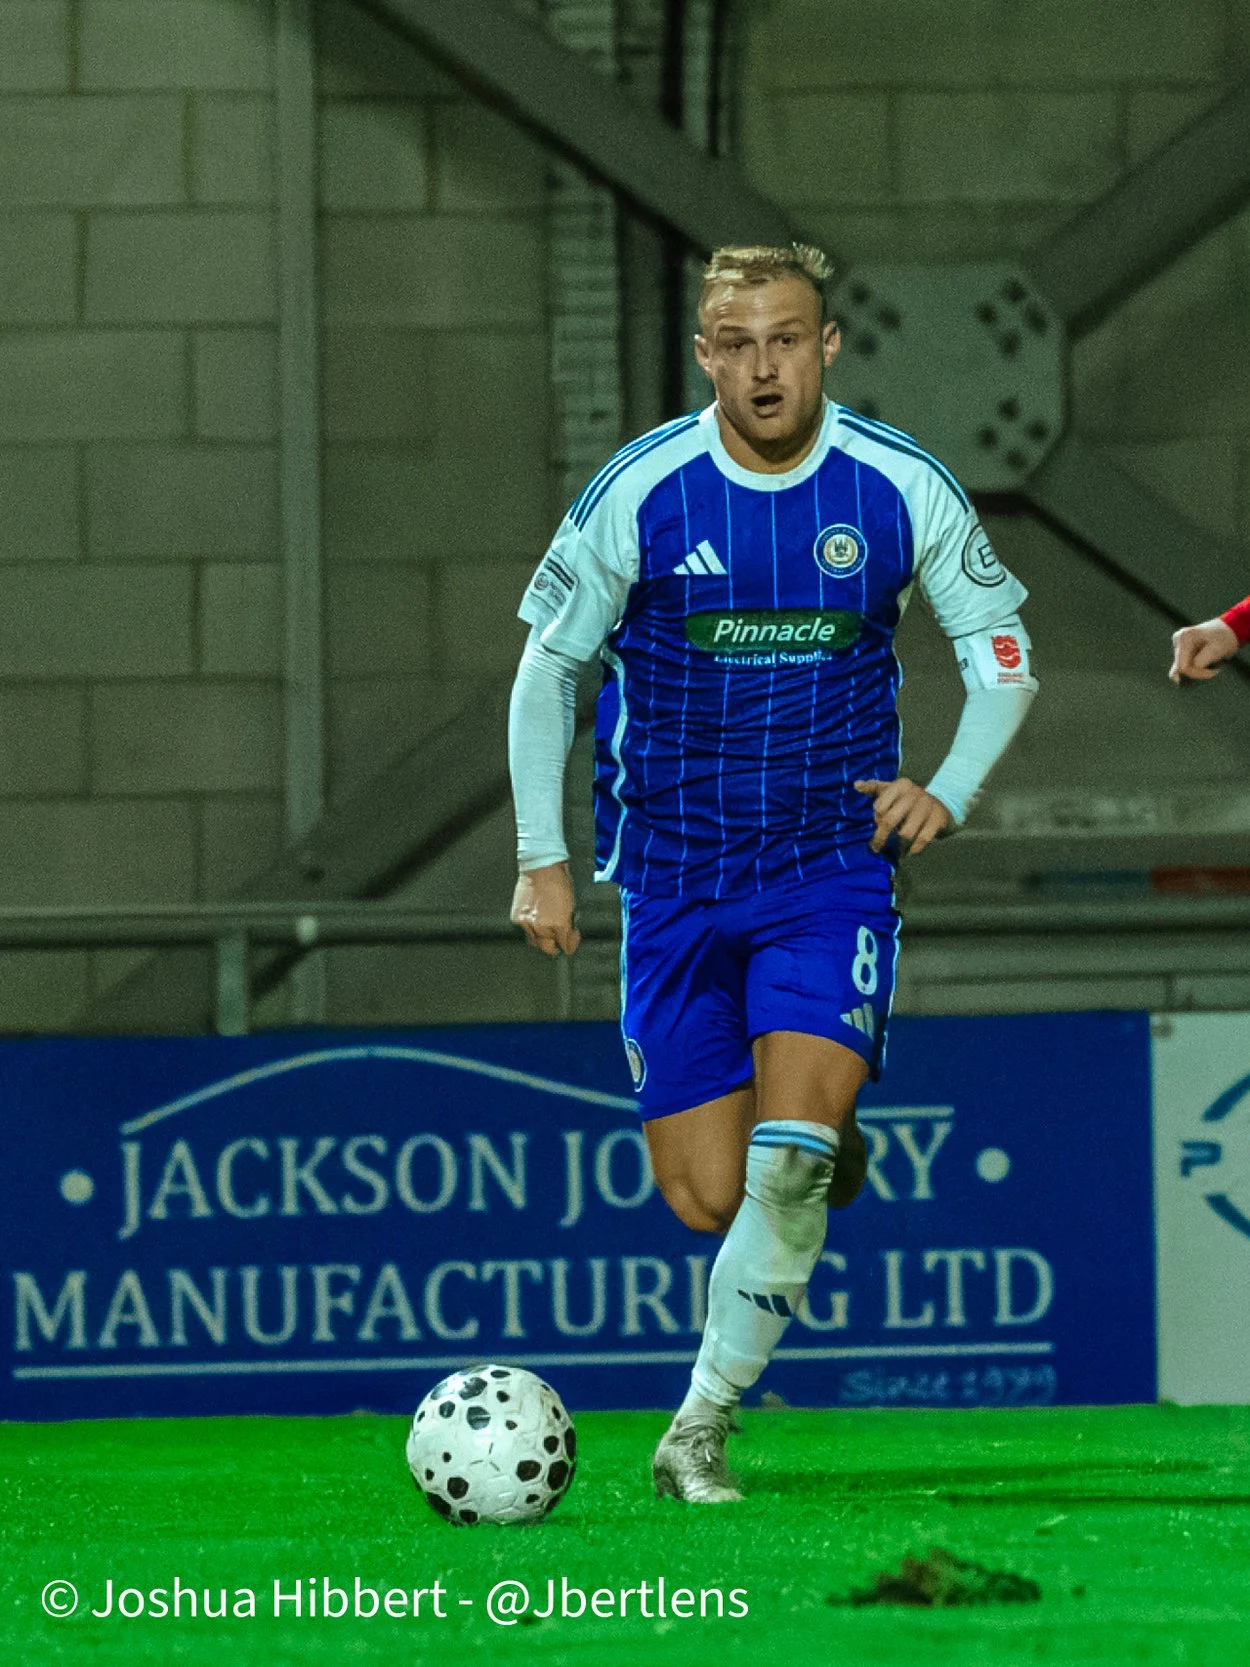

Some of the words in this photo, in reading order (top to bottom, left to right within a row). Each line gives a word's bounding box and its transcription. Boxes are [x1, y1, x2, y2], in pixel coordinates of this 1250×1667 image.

[713, 617, 836, 643] Pinnacle
[852, 925, 877, 995] 8
[117, 1132, 528, 1240] JACKSON
[559, 1121, 953, 1228] JORY
[1180, 1138, 1223, 1179] P
[11, 1248, 849, 1351] MANUFACTURIG
[882, 1247, 1055, 1329] LTD
